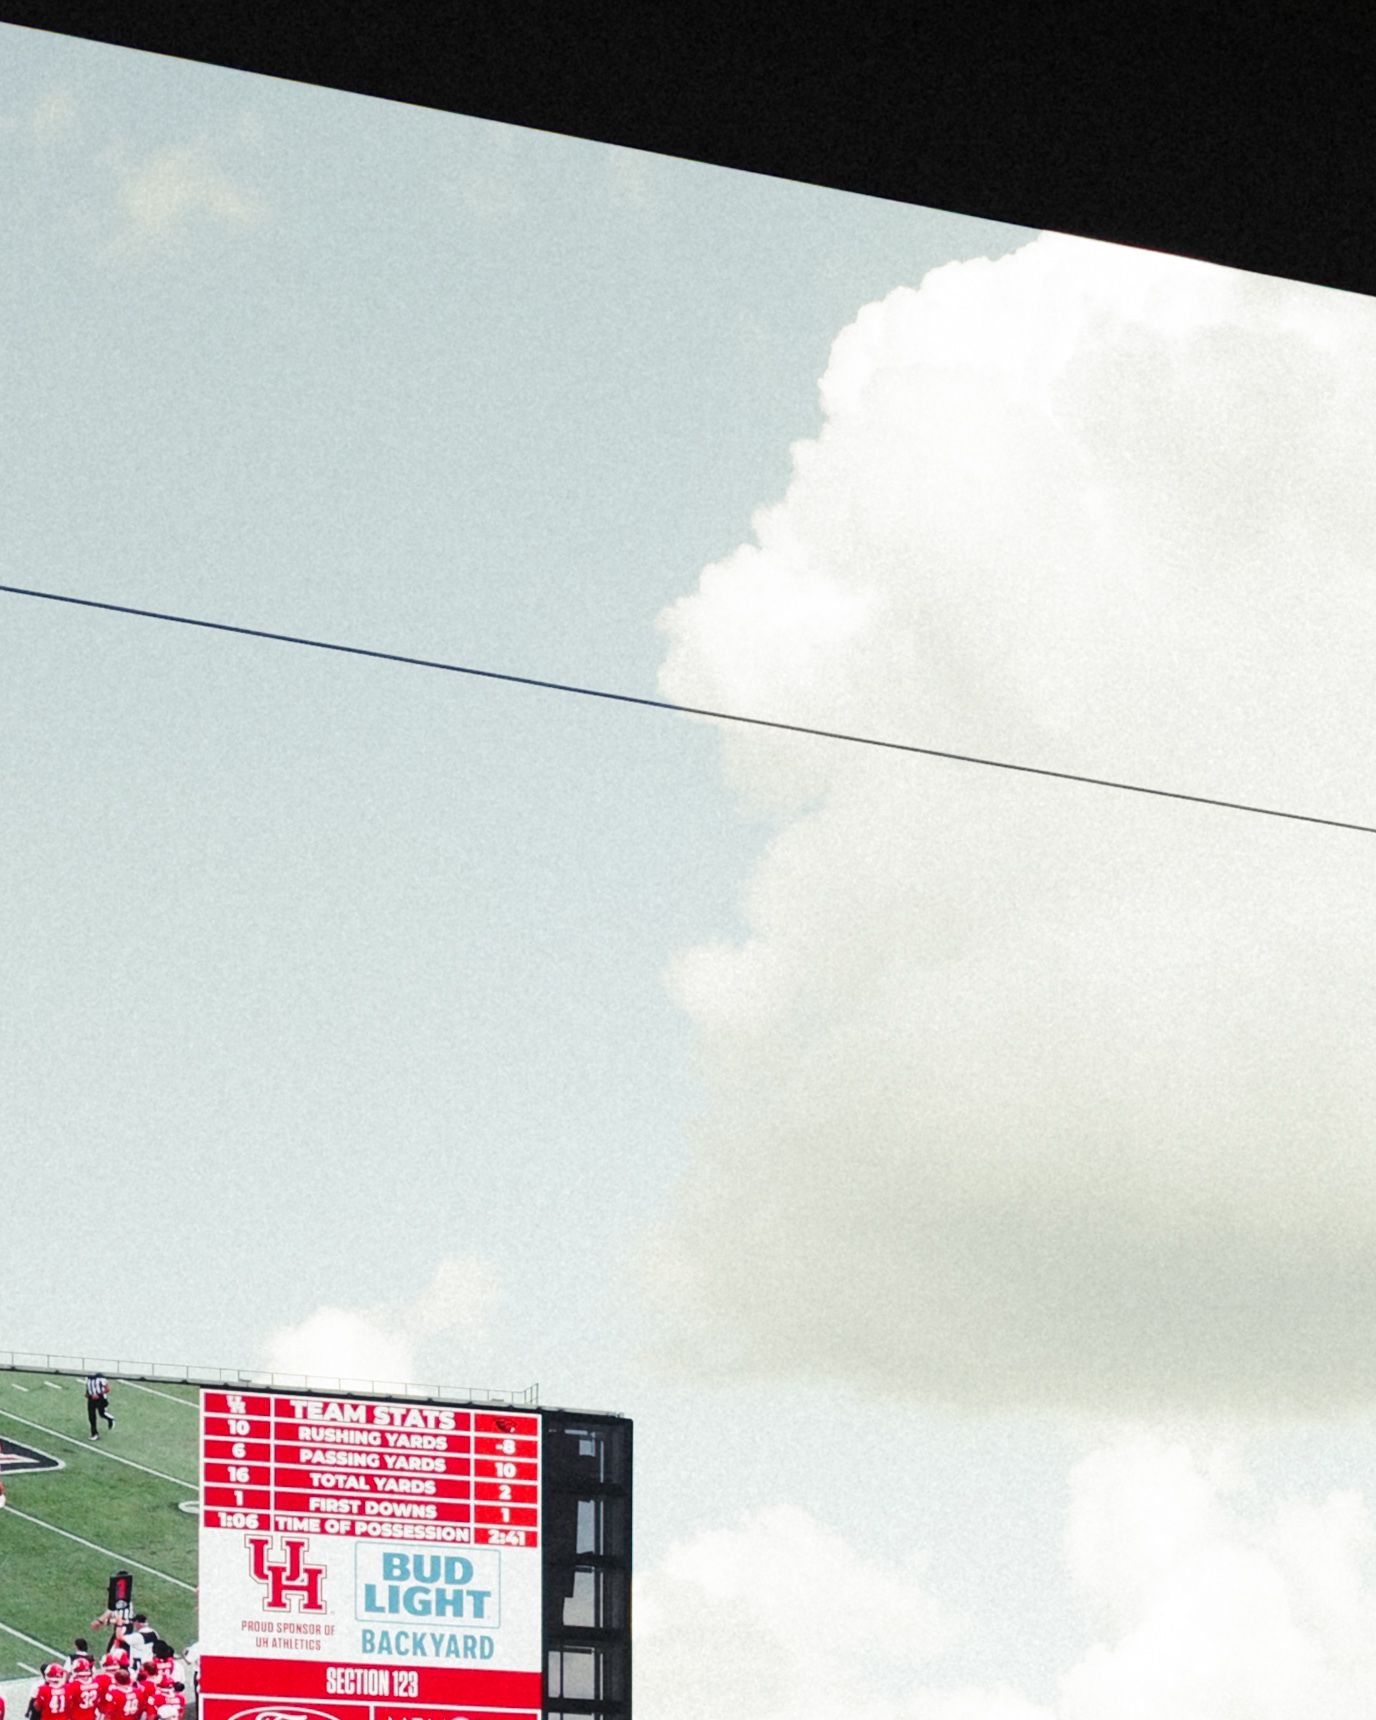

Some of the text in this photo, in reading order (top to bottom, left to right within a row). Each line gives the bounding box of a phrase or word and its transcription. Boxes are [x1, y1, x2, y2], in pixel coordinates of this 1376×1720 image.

[290, 1399, 456, 1430] TEAM STATS
[228, 1419, 250, 1435] 10
[298, 1427, 448, 1451] RUSHING YARDS
[232, 1442, 246, 1458] 6
[300, 1450, 447, 1473] PASSING YARDS
[495, 1462, 516, 1478] 10
[228, 1466, 249, 1482] 16
[310, 1472, 437, 1495] TOTAL YARDS
[234, 1490, 244, 1505] 1
[499, 1485, 511, 1500] 2
[309, 1497, 438, 1518] FIRST DOWNS
[501, 1508, 510, 1523] 1
[218, 1512, 259, 1530] 1:06
[276, 1516, 470, 1543] TIME OF POSSESSION
[488, 1529, 525, 1546] 2:41
[244, 1534, 328, 1615] UH
[382, 1552, 474, 1585] BUD
[364, 1584, 492, 1619] LIGHT
[241, 1620, 335, 1637] PROUD SPONSOR OF
[256, 1637, 321, 1651] UH ATHLETICS
[361, 1629, 494, 1660] BACKYARD
[326, 1667, 419, 1698] SECTION 123
